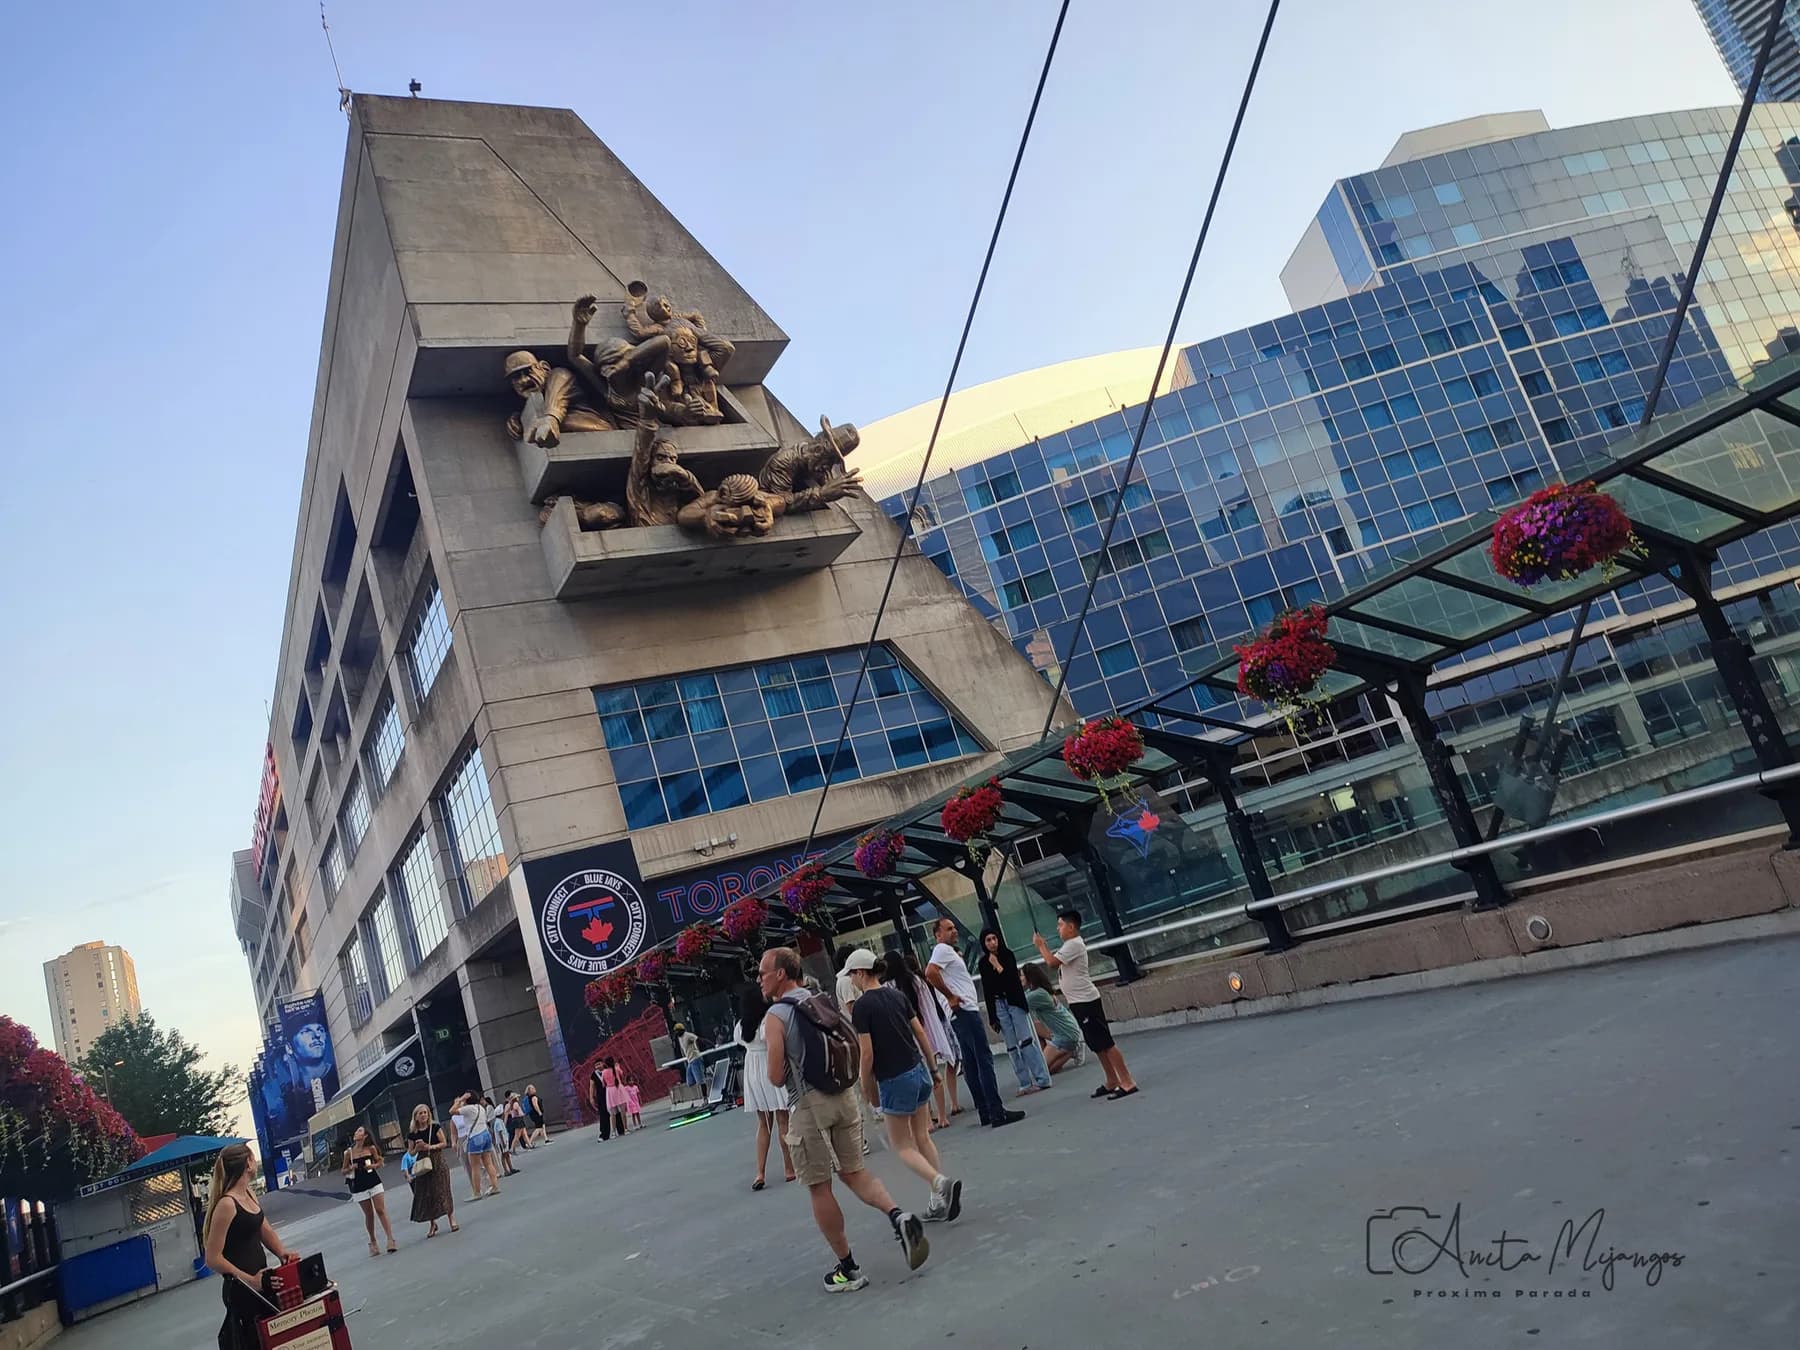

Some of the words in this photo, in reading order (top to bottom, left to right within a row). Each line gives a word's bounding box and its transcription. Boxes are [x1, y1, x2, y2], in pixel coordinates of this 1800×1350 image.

[583, 873, 604, 884] BLUE
[604, 875, 623, 891] JAYS
[657, 848, 827, 923] TORO
[546, 886, 569, 922] CONNECT
[629, 901, 642, 920] CITY
[546, 924, 560, 944] CITY
[621, 921, 642, 958] CONNECT
[567, 954, 587, 970] JAYS
[587, 959, 608, 971] BLUE
[269, 1315, 297, 1329] Memory
